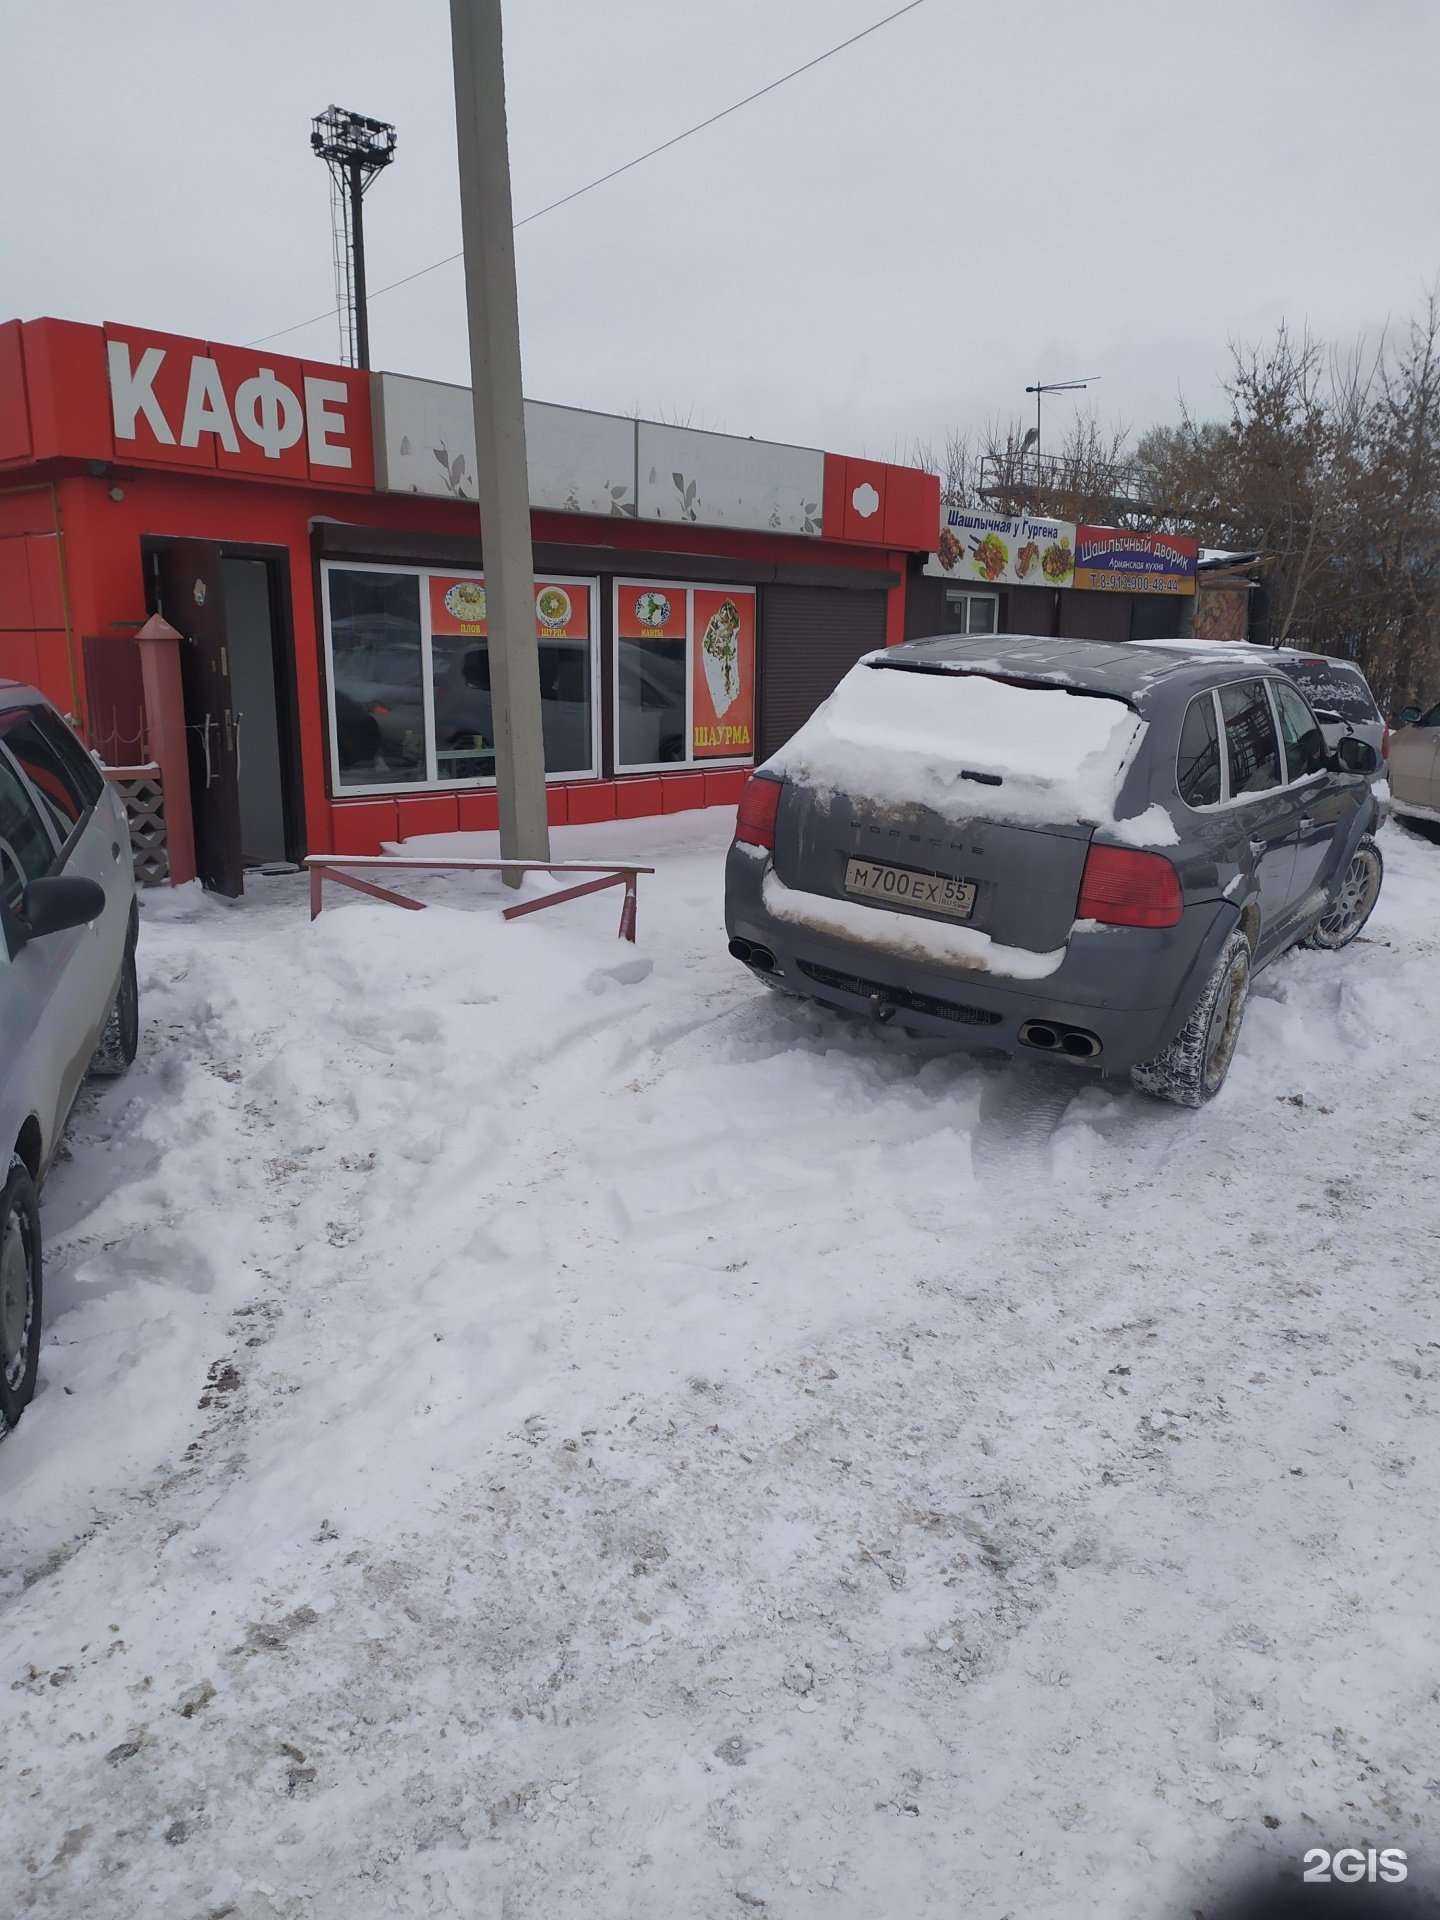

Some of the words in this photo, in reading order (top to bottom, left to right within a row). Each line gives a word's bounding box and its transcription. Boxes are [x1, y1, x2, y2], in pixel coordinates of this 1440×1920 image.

[107, 340, 352, 469] КАФЕ
[947, 509, 1011, 534] Шашлычная
[1013, 523, 1020, 538] у
[1021, 519, 1058, 540] Гургена
[1081, 534, 1152, 562] Шашлычный
[1108, 557, 1144, 571] Армянская
[694, 725, 750, 746] ШАУРМА
[850, 821, 985, 854] PORSCHE
[944, 881, 968, 901] 55
